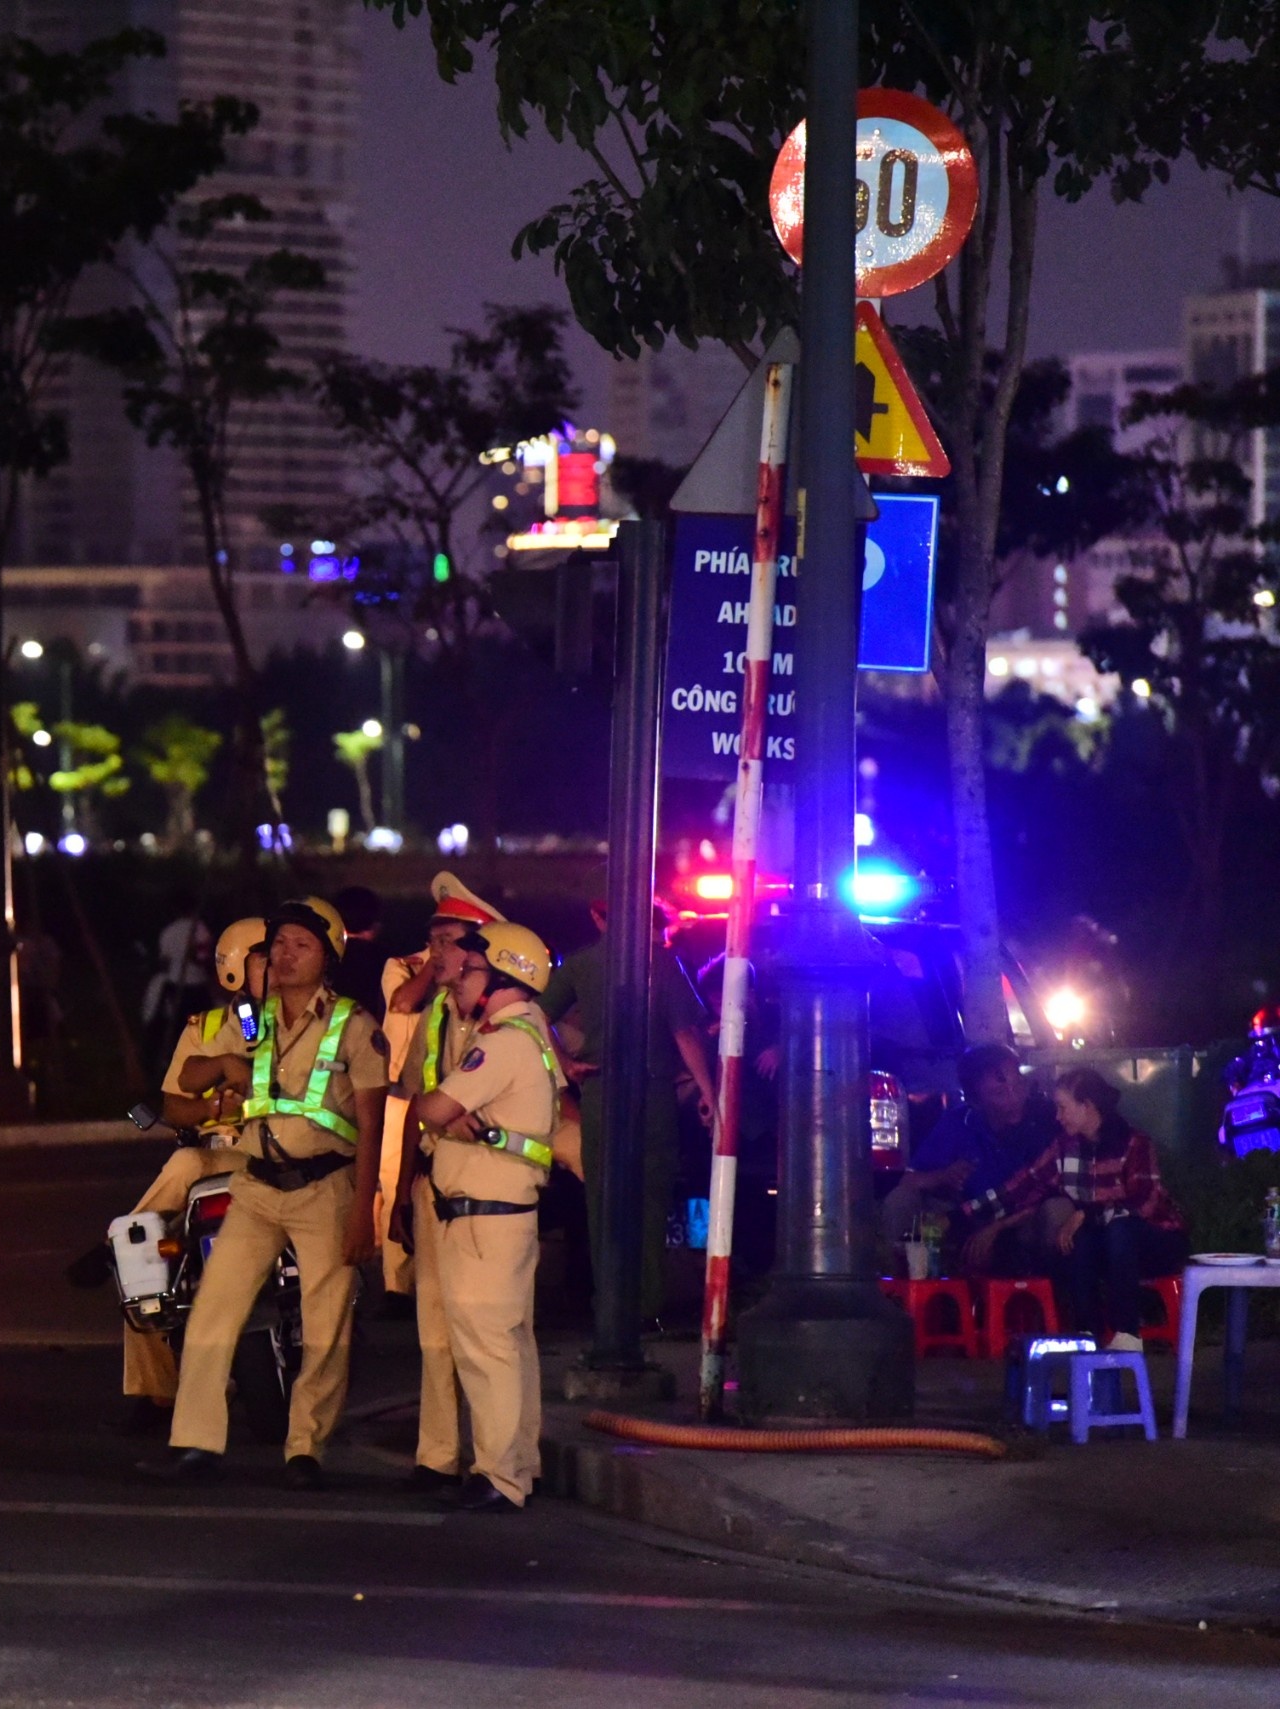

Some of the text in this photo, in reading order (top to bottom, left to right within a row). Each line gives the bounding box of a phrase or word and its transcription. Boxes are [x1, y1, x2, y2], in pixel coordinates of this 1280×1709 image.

[694, 546, 750, 575] PHÍA
[717, 601, 797, 626] AHAD
[772, 653, 794, 675] M
[671, 684, 737, 713] CÔNG
[711, 732, 796, 760] WOKS
